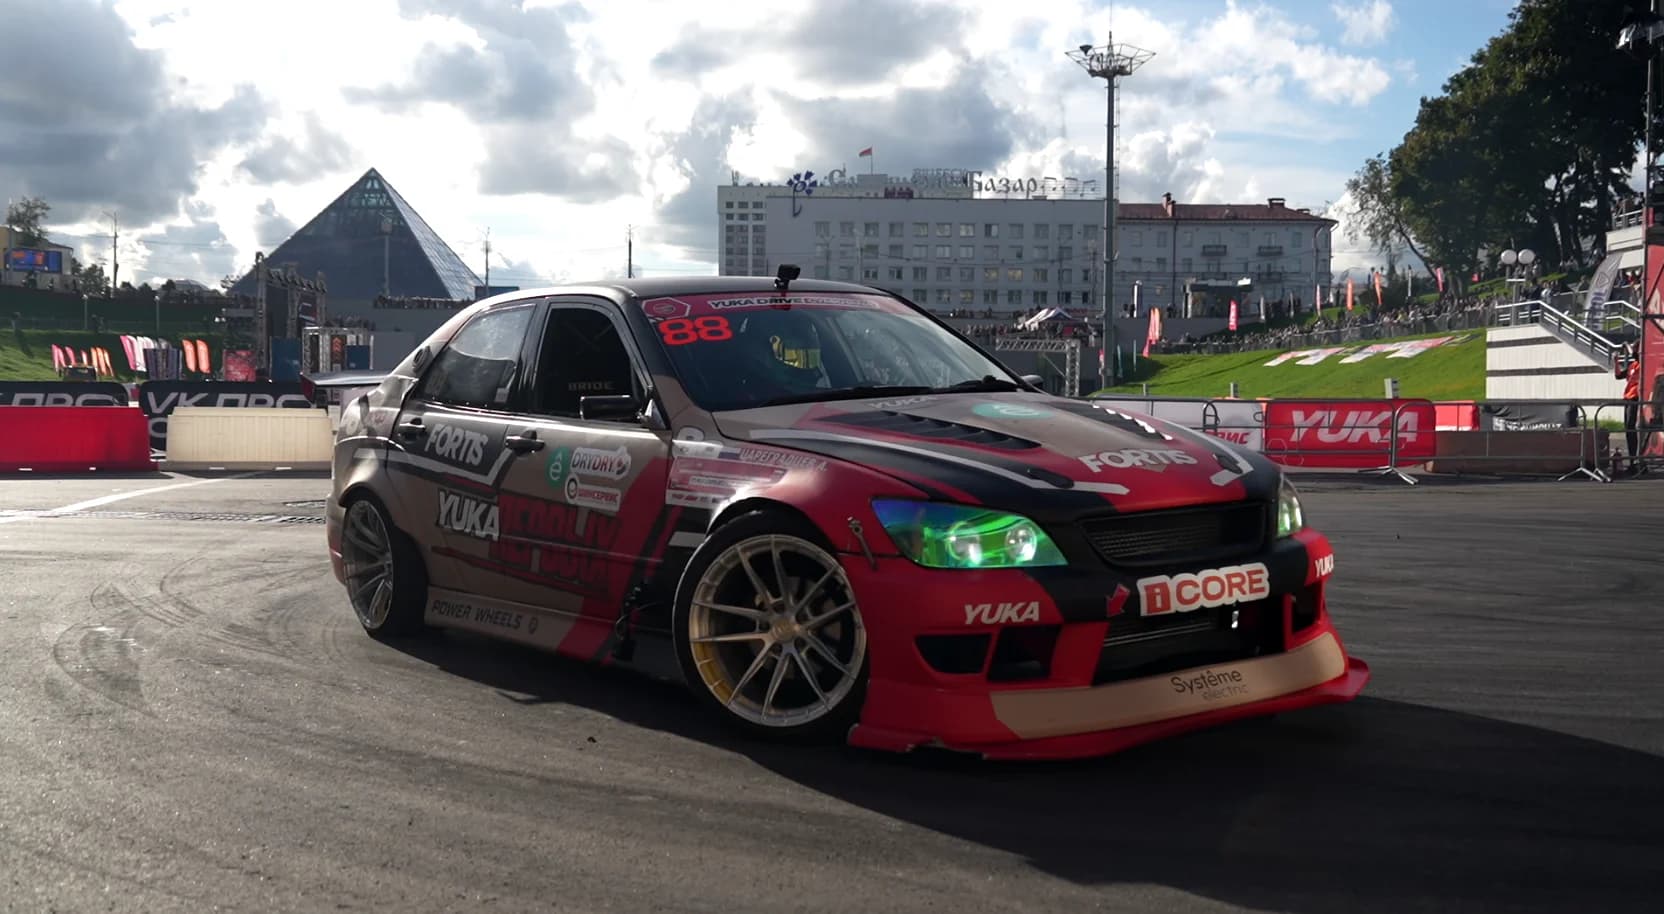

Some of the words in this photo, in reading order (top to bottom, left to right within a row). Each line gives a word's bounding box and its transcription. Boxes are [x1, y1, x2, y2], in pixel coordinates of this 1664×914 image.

[967, 171, 1037, 199] Базар
[711, 300, 752, 308] YUKA
[658, 316, 734, 345] 88
[1291, 410, 1419, 443] YUKA
[424, 423, 489, 466] FORTIS
[1080, 449, 1198, 473] FORTIS
[437, 490, 500, 542] YUKA
[431, 599, 472, 620] POWER
[474, 606, 525, 630] WHEELS
[964, 601, 1040, 625] YUKA
